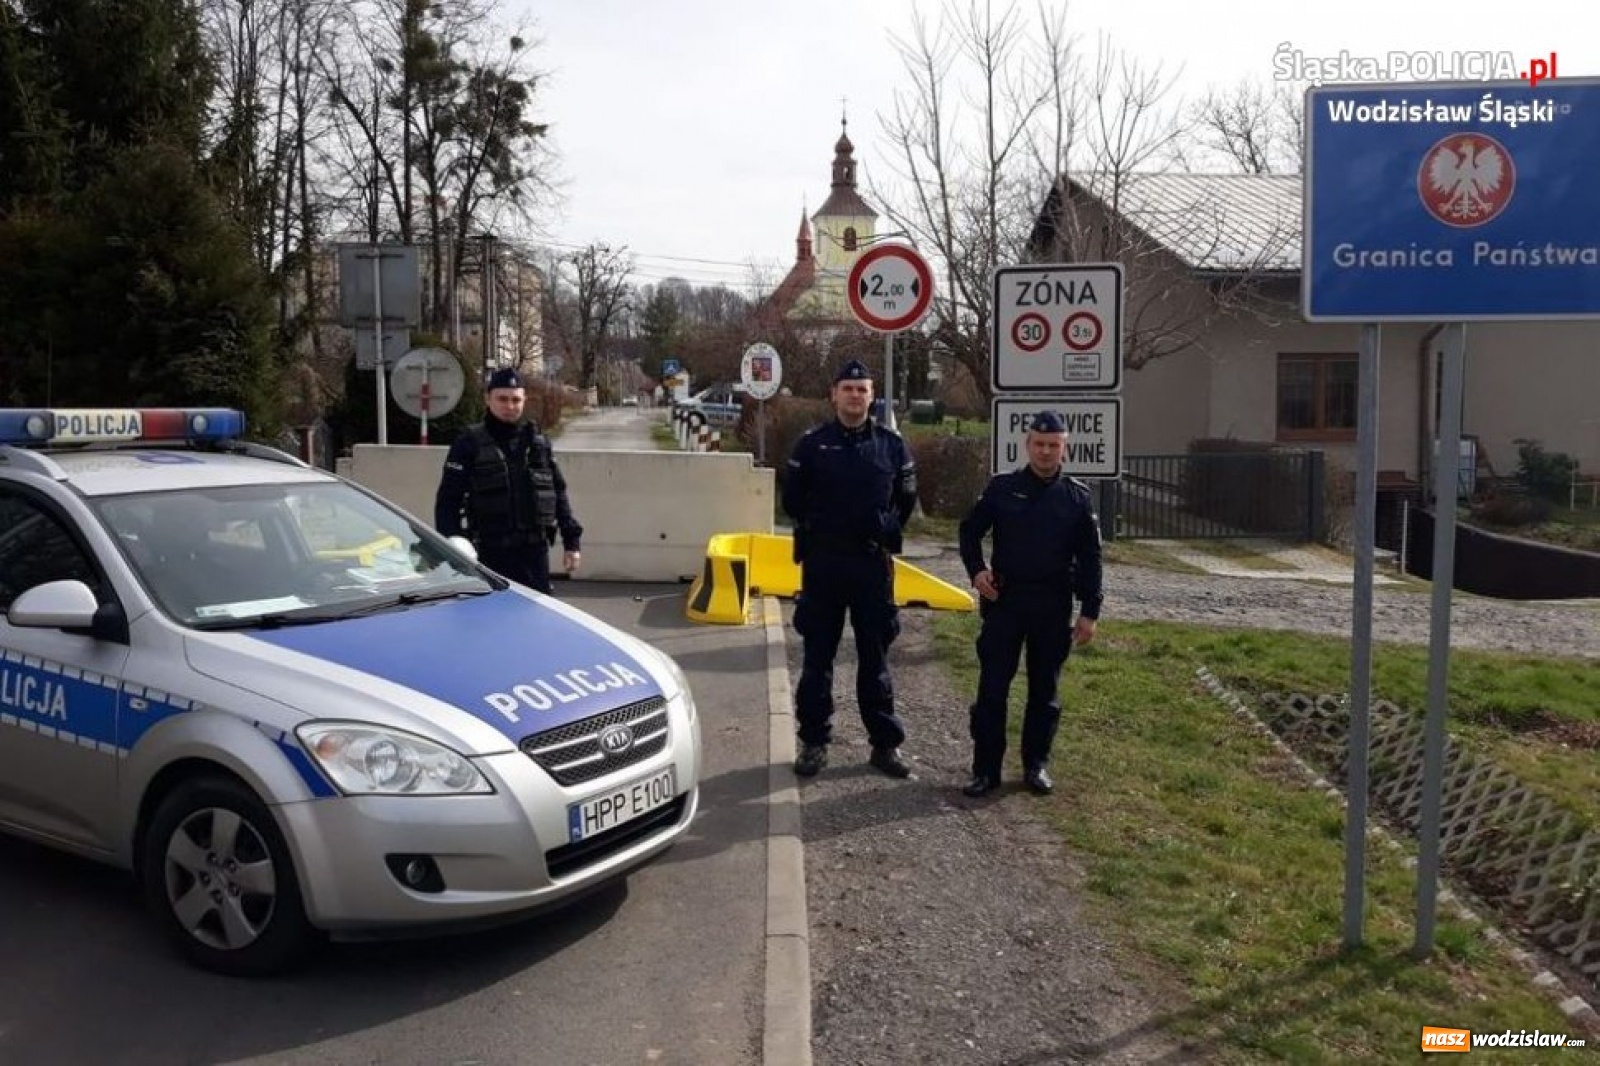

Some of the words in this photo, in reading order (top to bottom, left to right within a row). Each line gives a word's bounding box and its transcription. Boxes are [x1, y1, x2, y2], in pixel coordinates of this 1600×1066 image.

[1332, 242, 1453, 268] Granica
[1473, 240, 1598, 266] Państwa
[1015, 274, 1098, 306] ZÓNA
[883, 300, 897, 311] m
[1020, 324, 1043, 341] 30
[56, 414, 141, 437] POLICJA
[1010, 413, 1103, 434] PEVICE
[1007, 443, 1017, 463] U
[1, 669, 67, 721] LICJA
[484, 662, 647, 723] POLICJA
[606, 731, 629, 748] KIA
[583, 793, 626, 835] HPP
[632, 773, 671, 814] E100
